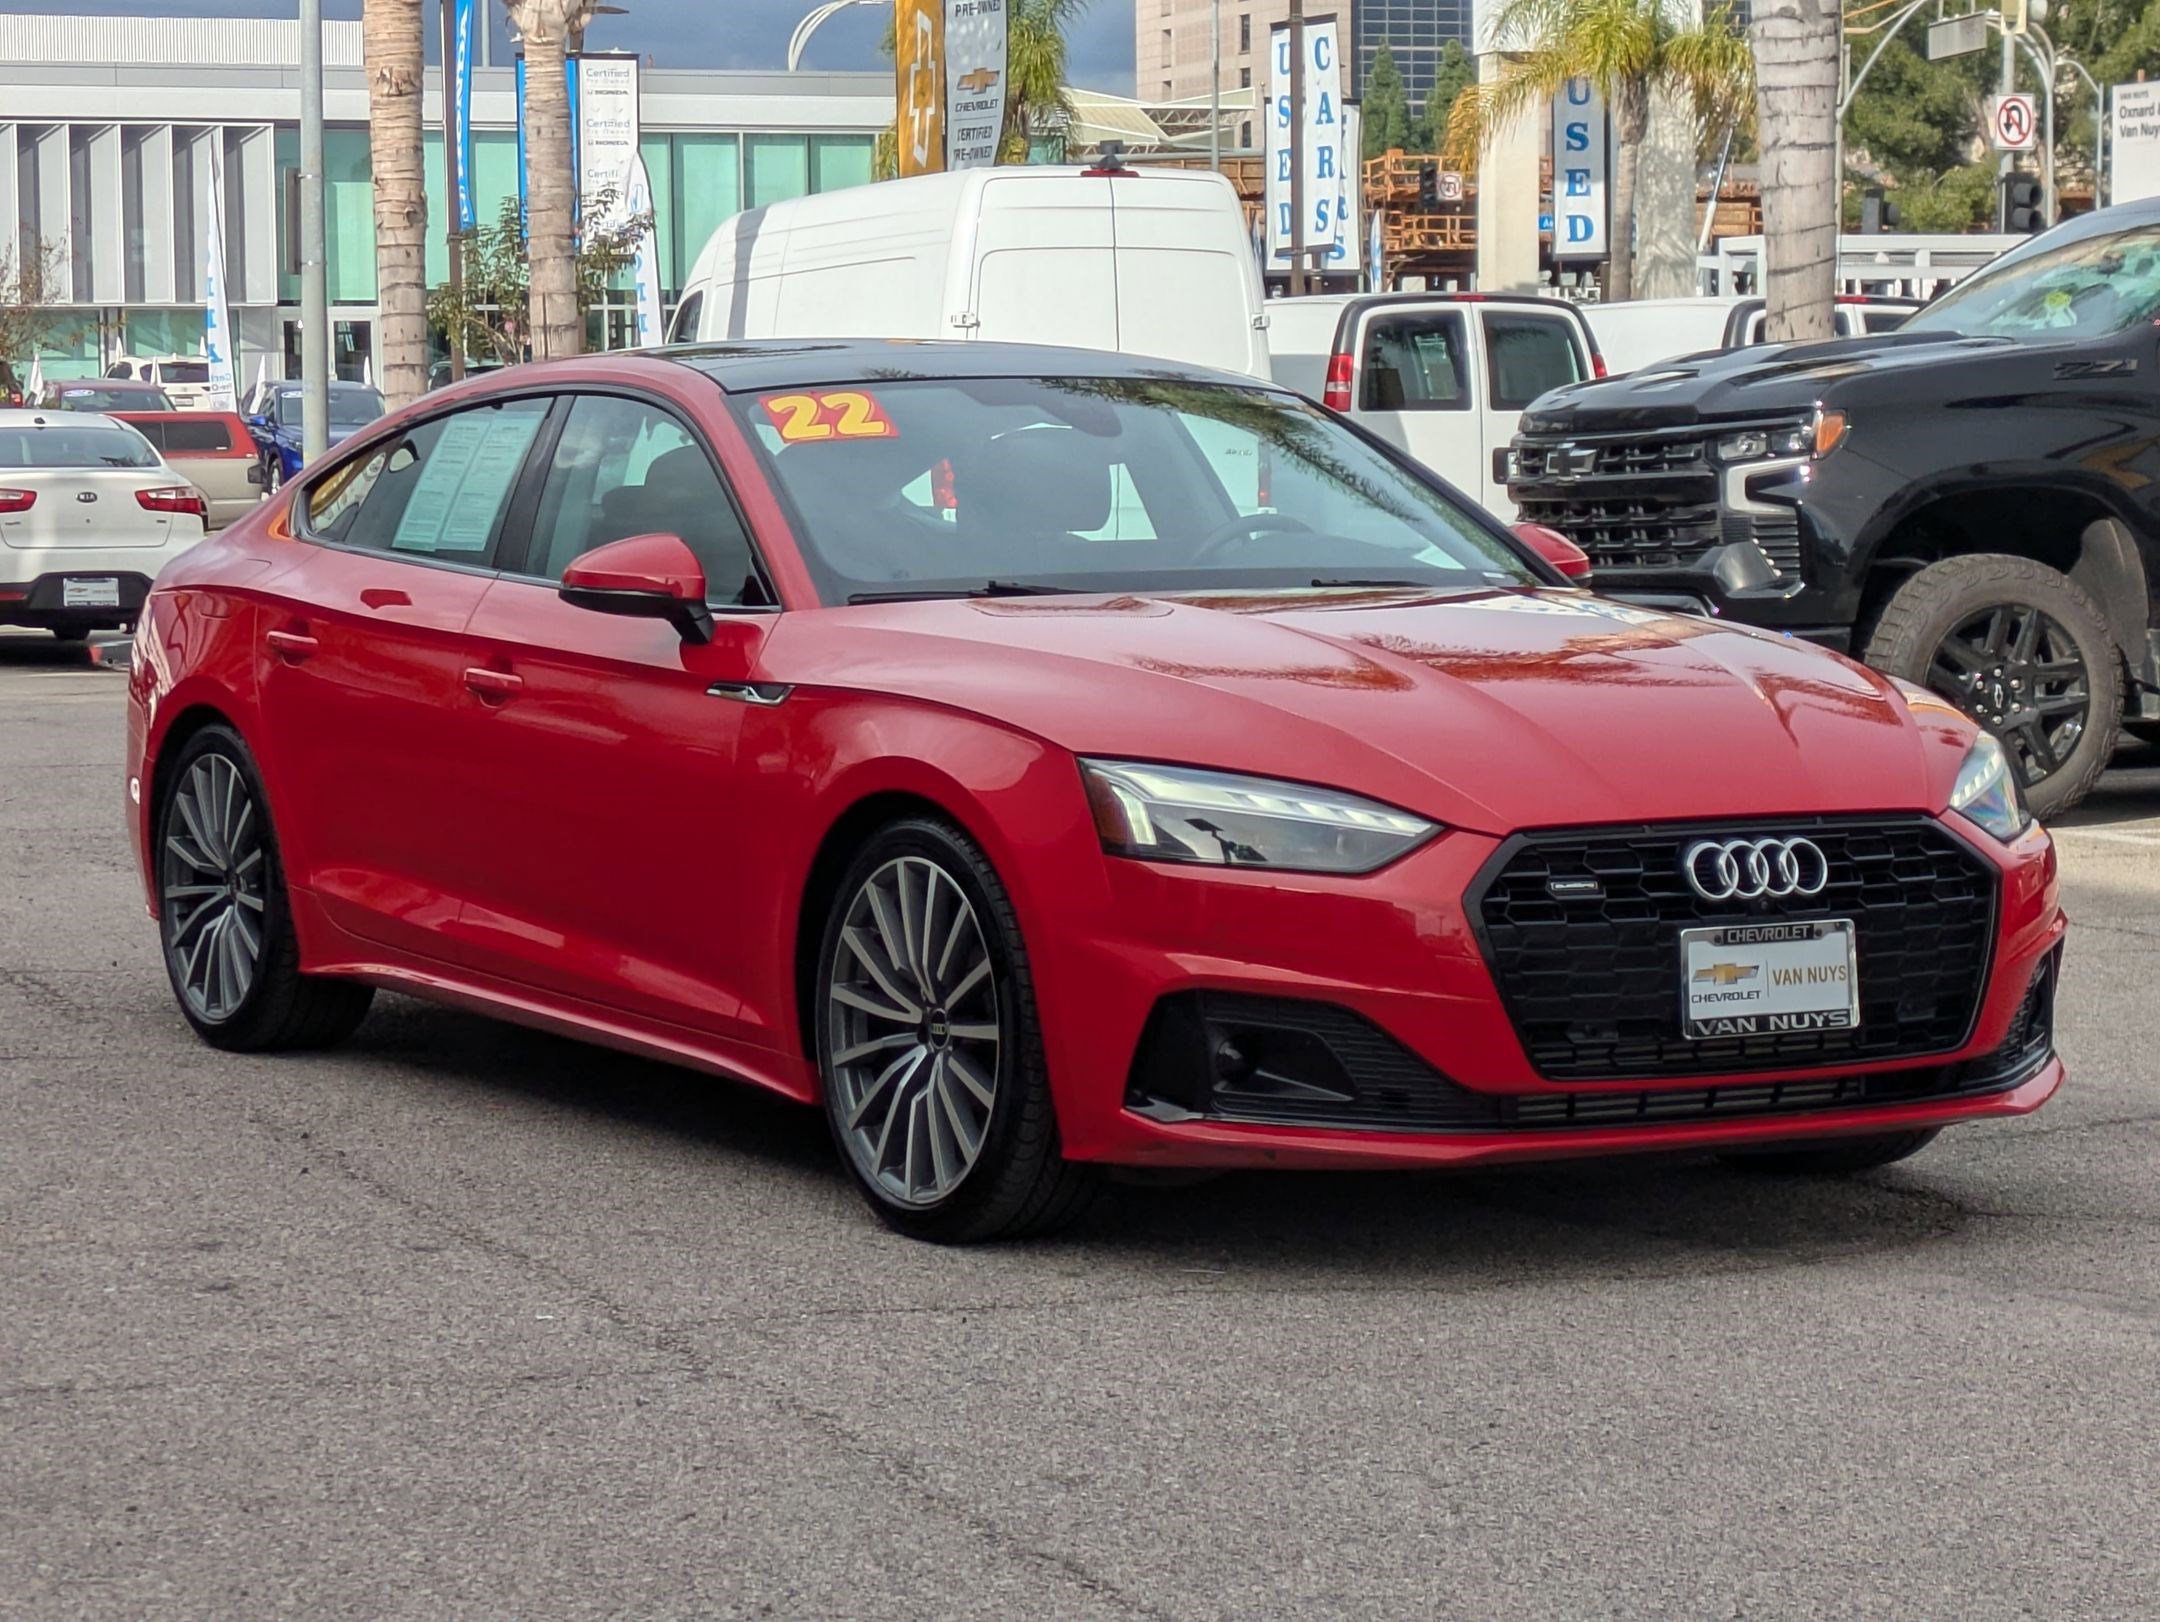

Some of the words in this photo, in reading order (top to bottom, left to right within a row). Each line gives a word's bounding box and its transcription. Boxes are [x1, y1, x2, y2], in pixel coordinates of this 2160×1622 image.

[955, 99, 999, 113] CHEVROLET
[2120, 102, 2155, 119] Oxnard
[1314, 36, 1335, 233] CARS
[2120, 124, 2138, 138] Van
[2141, 122, 2160, 139] Nuy
[1565, 79, 1594, 242] USED
[587, 168, 618, 178] Certifi
[768, 392, 890, 440] 22
[1727, 925, 1810, 943] CHEVROLET
[1772, 968, 1803, 986] VAN
[1808, 965, 1847, 983] NUYS
[1692, 991, 1761, 1003] CHEVROLET
[1695, 1017, 1756, 1036] VAN
[1769, 1010, 1848, 1031] NUYS
